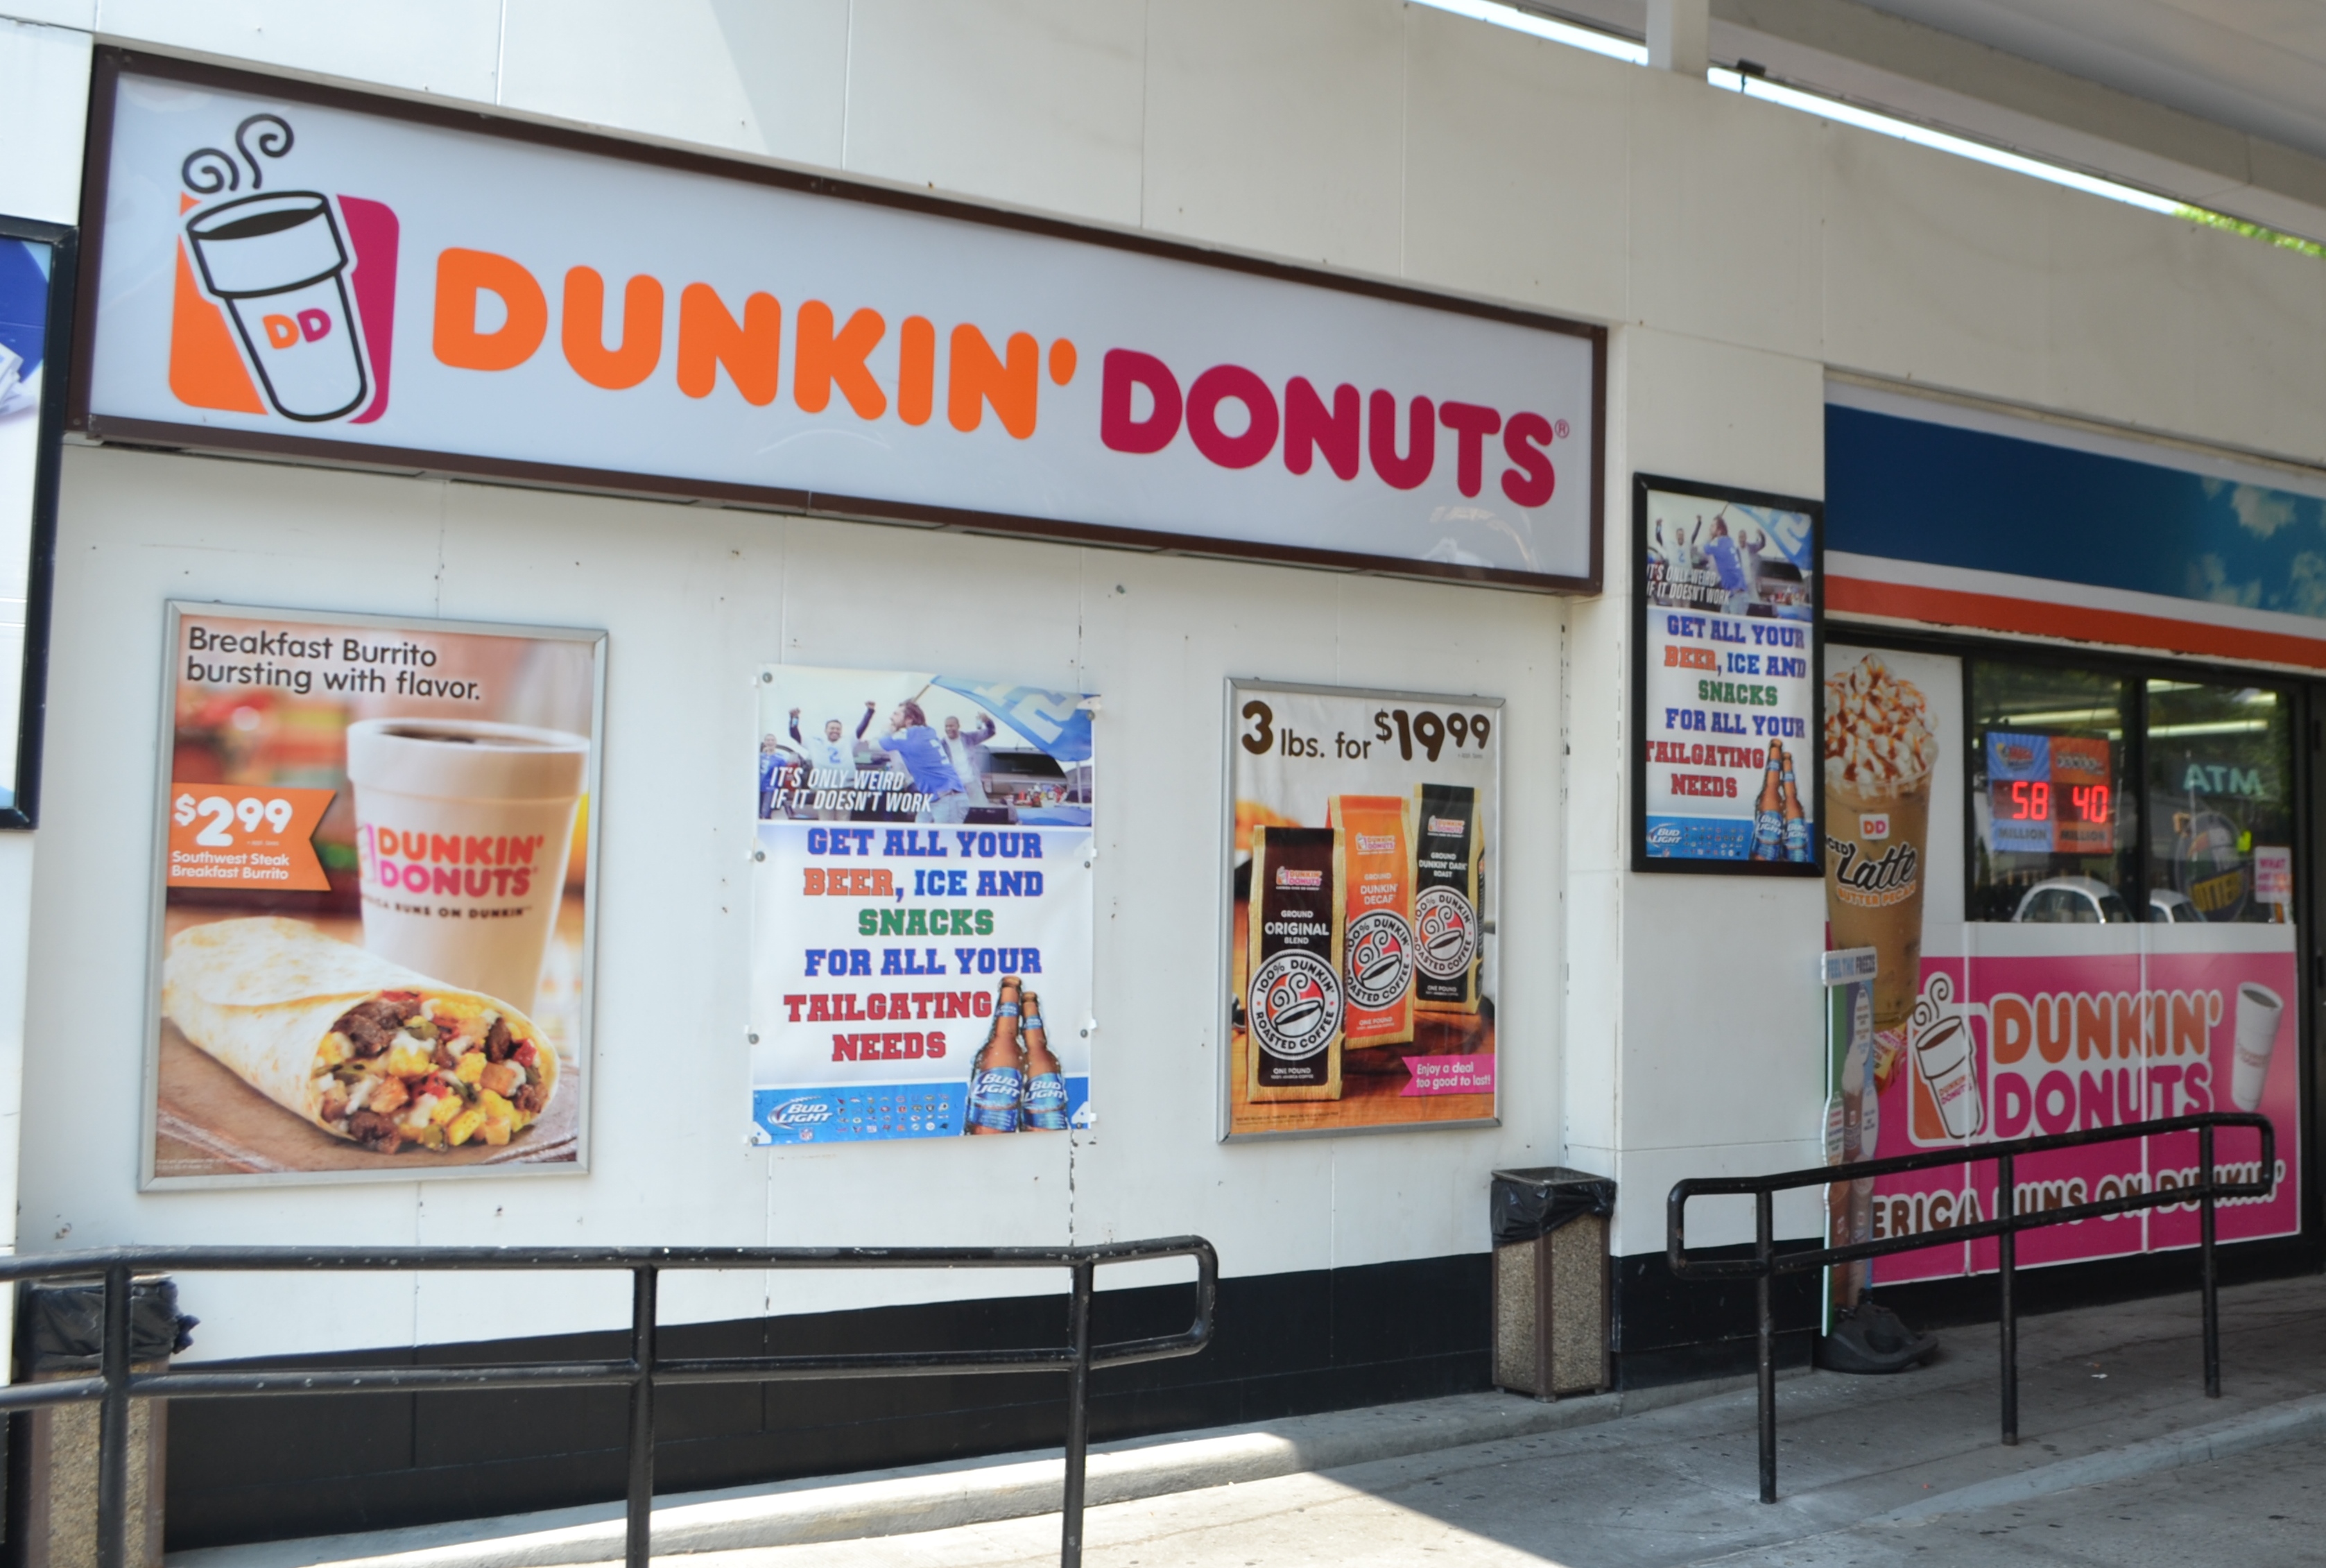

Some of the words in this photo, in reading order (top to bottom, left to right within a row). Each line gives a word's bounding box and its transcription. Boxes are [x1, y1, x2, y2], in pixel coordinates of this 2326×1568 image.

[433, 247, 1077, 440] DUNKIN'
[1666, 566, 1689, 583] ONLY
[1691, 569, 1716, 587] WEIRD
[1657, 581, 1667, 598] IT
[1706, 587, 1731, 605] WORK
[1667, 614, 1705, 638] GET
[1710, 619, 1746, 643] ALL
[1751, 624, 1804, 649] YOUR
[189, 626, 334, 660] Breakfast
[343, 638, 437, 667] Burrito
[1664, 645, 1723, 676] BEER,
[1727, 652, 1760, 675] ICE
[1766, 655, 1806, 678] AND
[187, 655, 311, 694] bursting
[323, 667, 386, 693] with
[396, 670, 480, 700] flavor.
[1698, 680, 1778, 706] SNACKS
[1242, 700, 1273, 755] 3
[1281, 728, 1325, 758] lbs.
[1335, 732, 1372, 759] for
[1665, 707, 1706, 732] FOR
[1711, 711, 1747, 735] ALL
[1752, 715, 1806, 739] YOUR
[1646, 741, 1765, 769] TAILGATING
[770, 766, 803, 789] IT'S
[807, 768, 850, 790] ONLY
[854, 770, 904, 791] WEIRD
[1671, 773, 1738, 798] NEEDS
[2182, 764, 2265, 796] ATM
[770, 788, 788, 809] IF
[792, 789, 809, 810] IT
[813, 789, 881, 811] DOESN'T
[885, 793, 935, 813] WORK
[2013, 781, 2049, 820] 58
[2072, 785, 2109, 823] 40
[1652, 835, 1682, 844] LIGHT
[1657, 828, 1680, 836] BUD
[1863, 820, 1887, 835] DD
[378, 827, 544, 866] DUNKIN'
[807, 828, 875, 856] GET
[883, 829, 947, 857] ALL
[956, 832, 1043, 859] YOUR
[1430, 852, 1457, 861] GROUND
[1825, 836, 1849, 855] CED
[172, 850, 248, 864] Southwest
[250, 853, 290, 866] Steak
[172, 864, 239, 877] Breakfast
[242, 867, 289, 880] Burrito
[1837, 843, 1916, 890] Latte
[379, 860, 532, 897] DONUTS
[803, 868, 904, 902] BEER,
[914, 869, 967, 897] ICE
[976, 870, 1044, 897] AND
[1360, 883, 1399, 895] DUNKIN'
[858, 908, 994, 936] SNACKS
[1280, 910, 1313, 918] GROUND
[1264, 922, 1329, 936] ORIGINAL
[1284, 936, 1309, 945] BLEND
[1348, 922, 1370, 952] 00%
[804, 949, 872, 976] FOR
[881, 948, 946, 976] ALL
[954, 947, 1042, 974] YOUR
[1447, 940, 1472, 970] COFFEE
[1257, 963, 1285, 994] 100%
[1291, 960, 1335, 993] DUNKIN'
[1347, 970, 1379, 1002] OASTED
[1382, 963, 1410, 999] COFFEE
[784, 991, 992, 1022] TAILGATING
[1256, 1012, 1296, 1050] ROASTED
[1300, 1011, 1334, 1049] COFFEE
[1993, 992, 2221, 1064] DUNKIN'
[831, 1031, 946, 1062] NEEDS
[981, 1074, 1019, 1088] BUD
[1416, 1078, 1431, 1088] too
[1432, 1075, 1458, 1090] good
[1460, 1076, 1471, 1086] to
[1473, 1074, 1491, 1086] last!
[1417, 1063, 1441, 1076] Enjoy
[1442, 1065, 1449, 1073] a
[1452, 1062, 1474, 1073] deal
[972, 1084, 1020, 1098] LIGHT
[1024, 1089, 1064, 1102] LIGHT
[1029, 1080, 1062, 1092] BUD
[1994, 1062, 2211, 1138] DONUTS
[779, 1112, 834, 1124] LIGHT
[787, 1103, 828, 1114] BUD
[1872, 1193, 1985, 1239] ERICA
